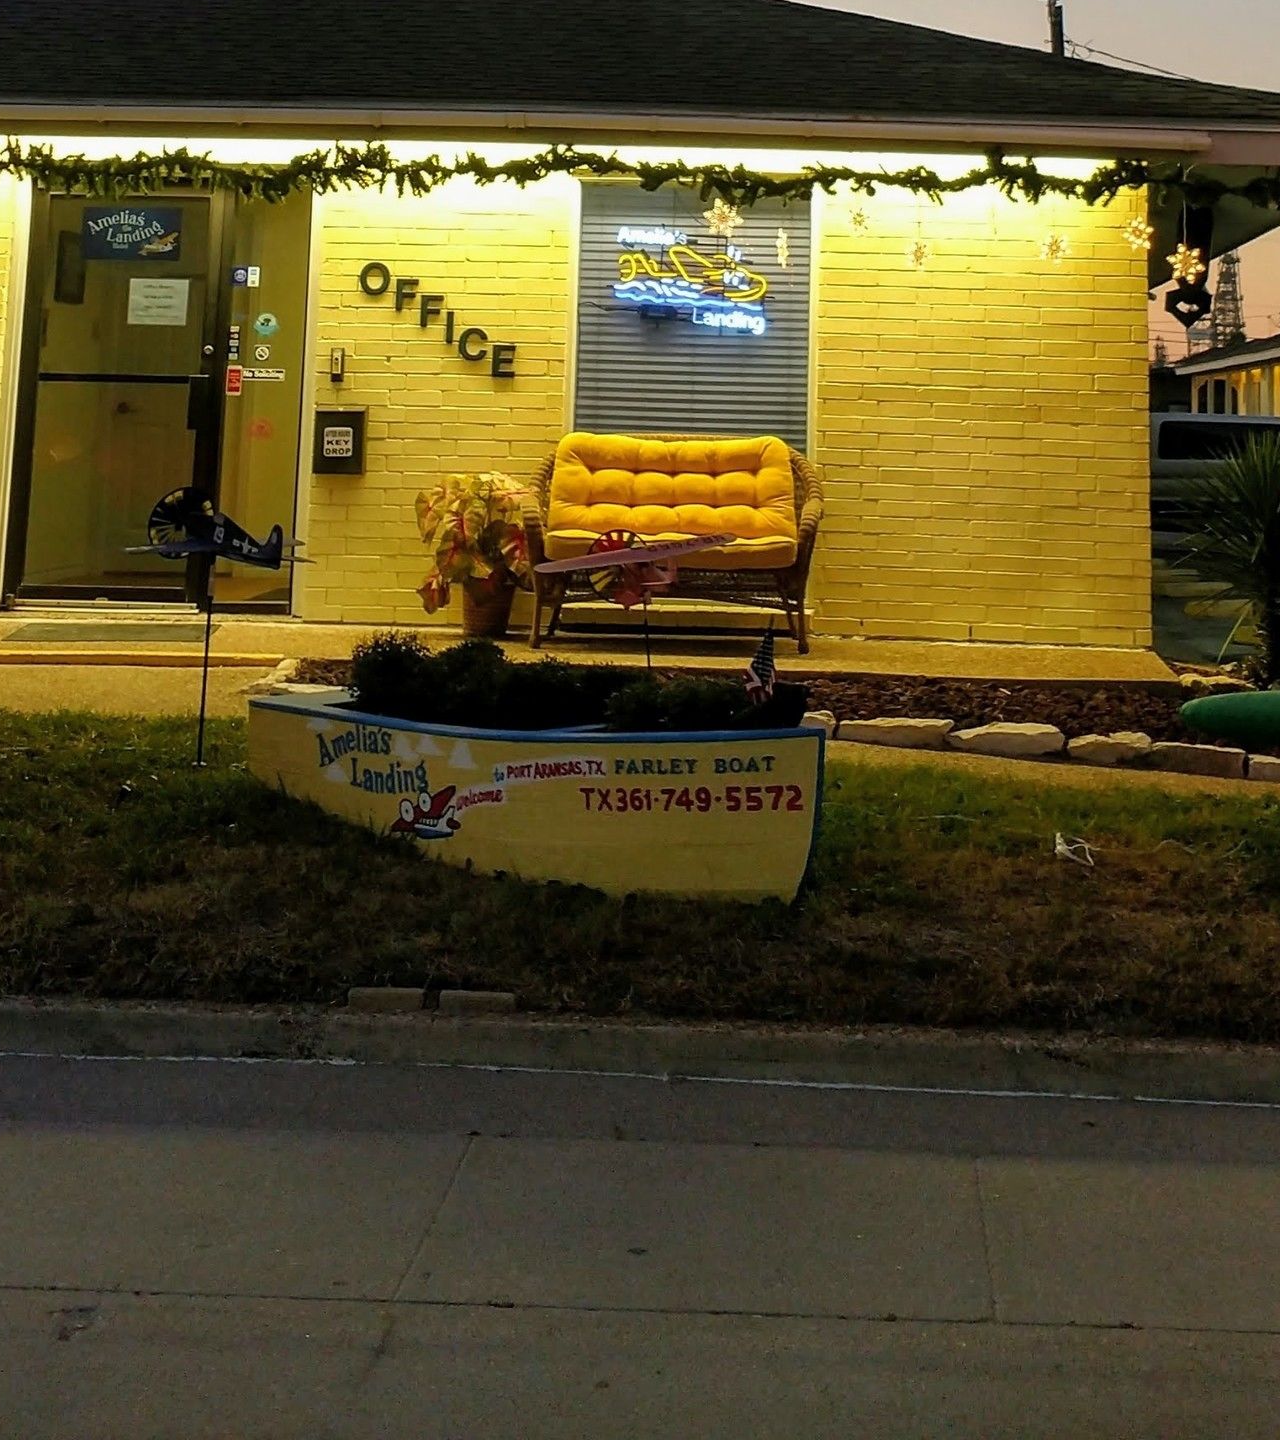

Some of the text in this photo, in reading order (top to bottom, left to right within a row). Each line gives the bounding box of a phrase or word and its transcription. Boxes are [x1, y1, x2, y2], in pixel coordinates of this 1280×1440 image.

[106, 220, 165, 244] Landing
[616, 225, 688, 246] Amelia's
[359, 261, 517, 378] OFFICE
[692, 306, 767, 336] Landing
[316, 724, 393, 768] Amelia's
[350, 757, 429, 795] Landing
[493, 766, 505, 782] to
[506, 762, 533, 780] PORT
[614, 755, 776, 776] FARLEY BOAT
